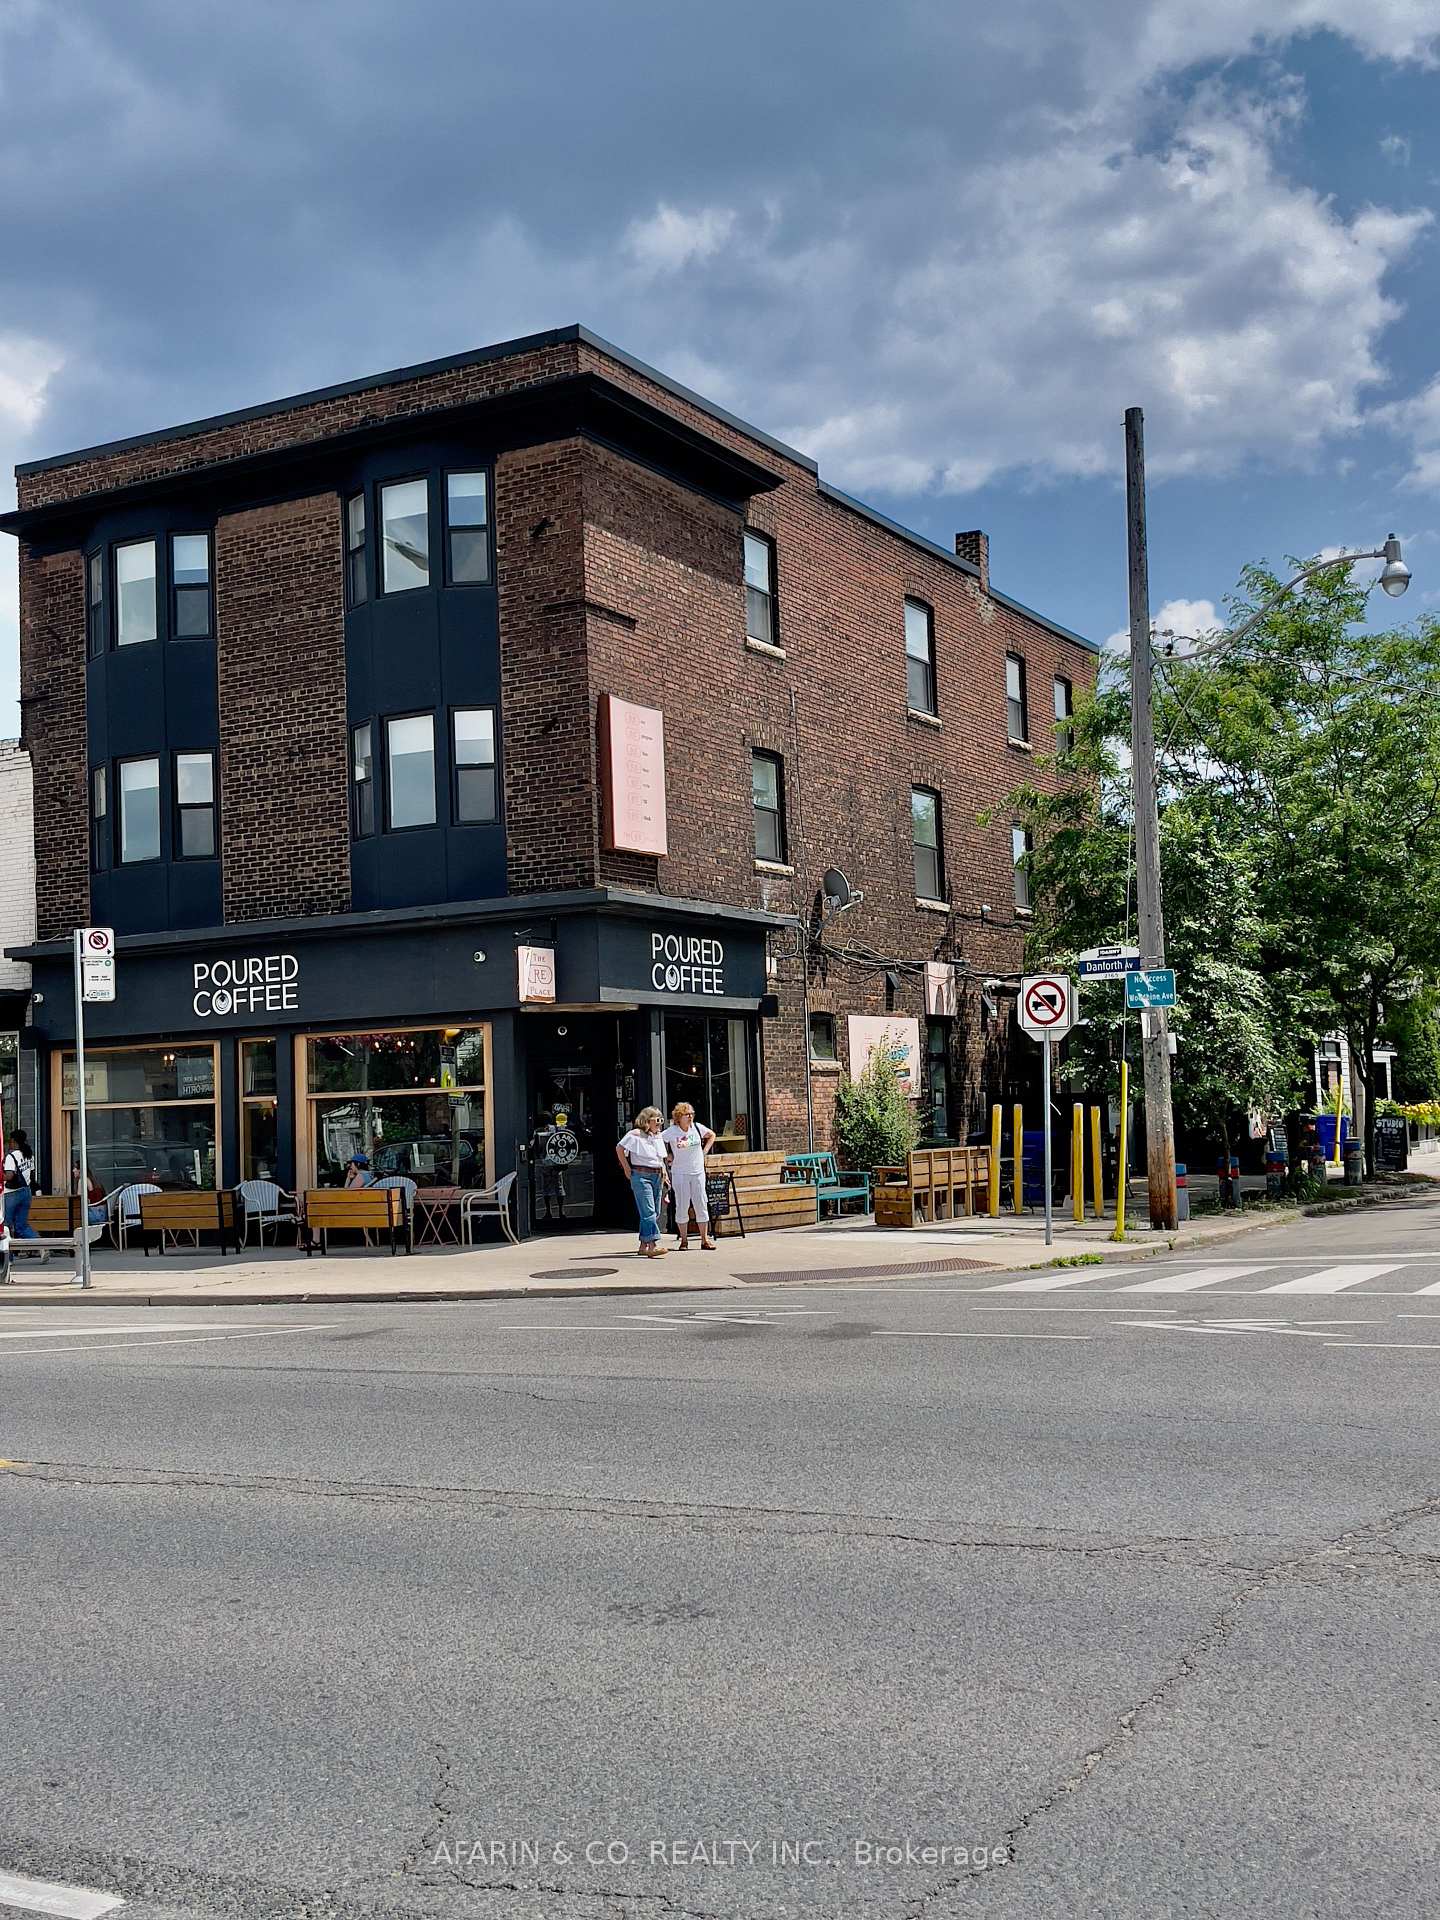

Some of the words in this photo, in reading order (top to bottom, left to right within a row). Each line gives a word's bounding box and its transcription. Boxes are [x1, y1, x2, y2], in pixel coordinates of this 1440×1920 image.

[651, 933, 724, 966] POURED
[193, 954, 299, 989] POURED
[1086, 960, 1123, 972] Danforth
[651, 962, 725, 995] COFFEE
[1134, 975, 1143, 984] No
[530, 987, 551, 996] PLACE
[1161, 992, 1174, 1000] Ave
[193, 983, 299, 1017] COFFEE
[1375, 1119, 1404, 1128] STUDIO
[550, 1135, 560, 1145] WE
[562, 1134, 575, 1144] ARE
